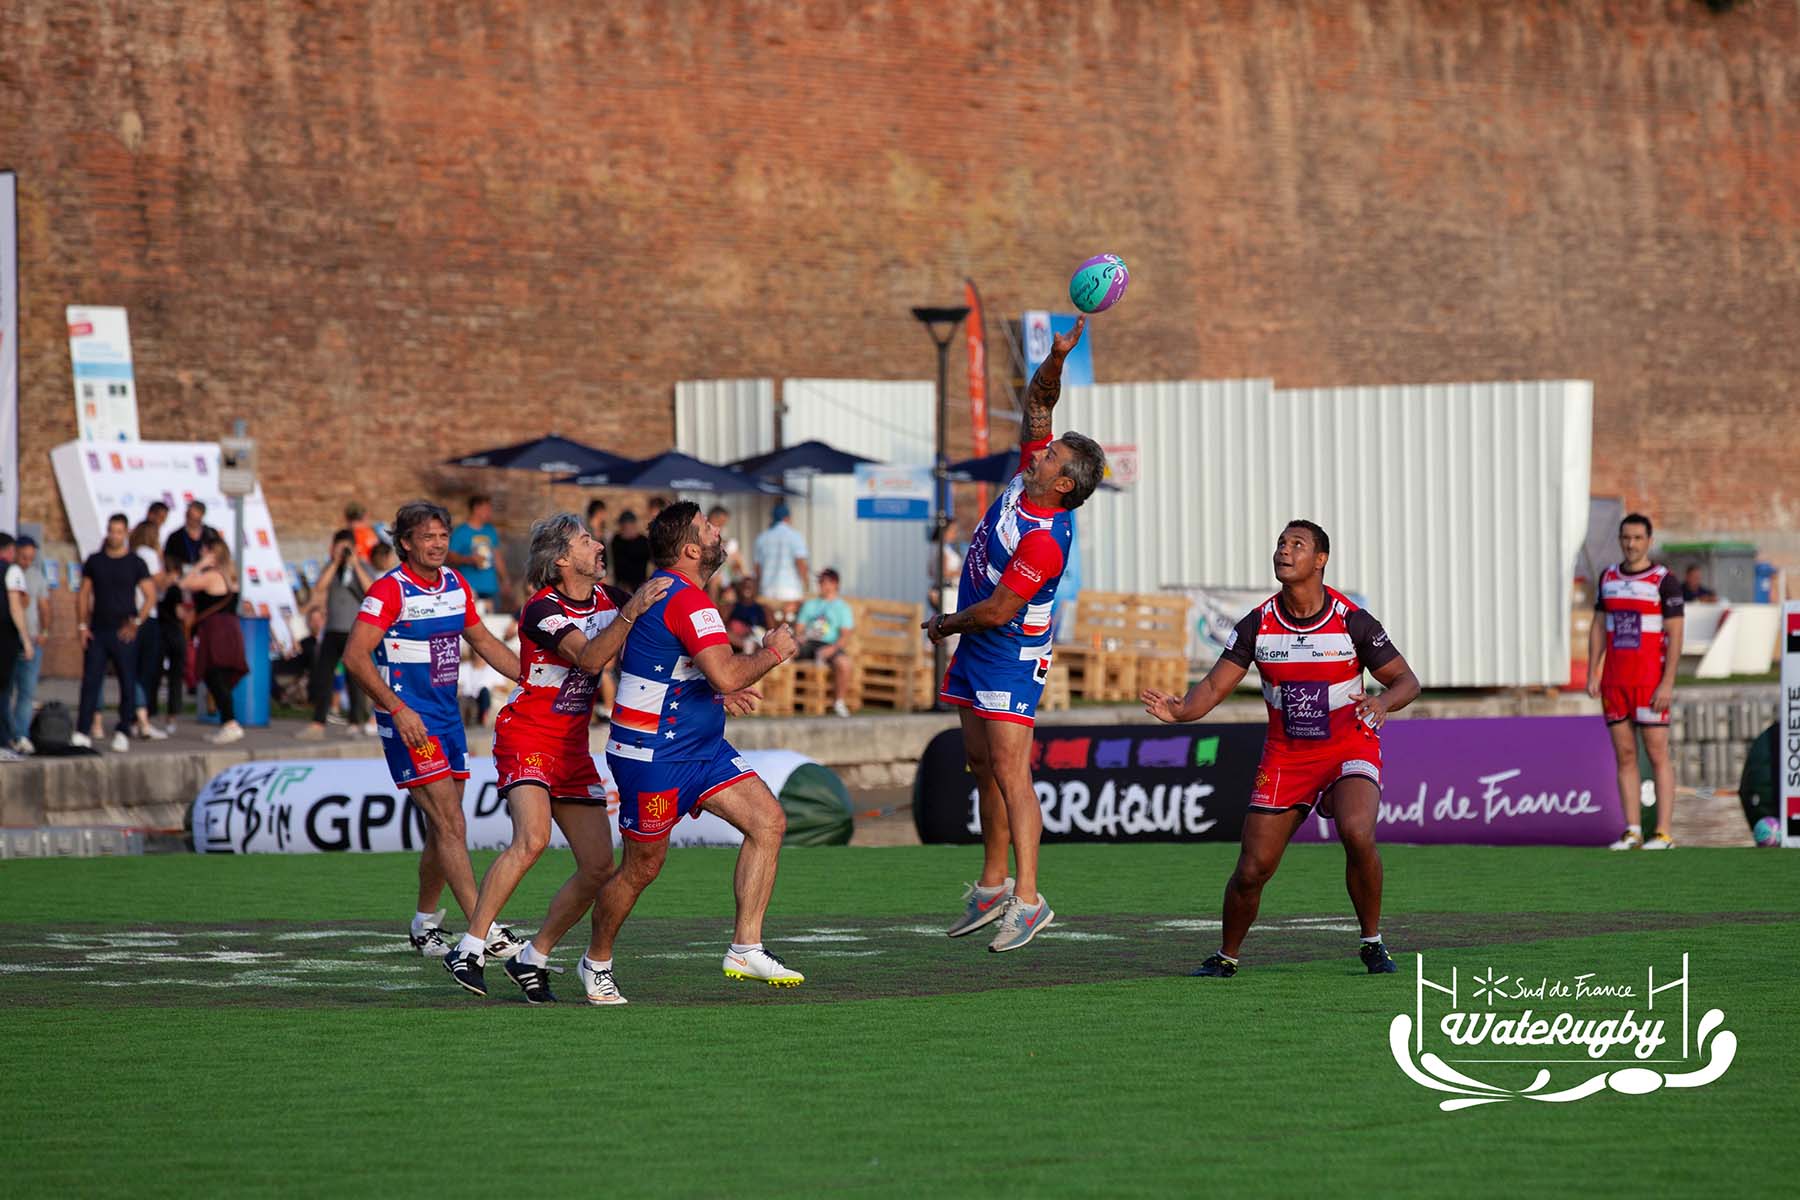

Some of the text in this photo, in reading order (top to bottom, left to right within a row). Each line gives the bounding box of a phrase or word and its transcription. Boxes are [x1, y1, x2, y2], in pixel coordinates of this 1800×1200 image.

[1269, 650, 1289, 658] GPM
[1296, 687, 1321, 702] Sud
[1286, 703, 1326, 720] France
[1298, 700, 1313, 711] de
[1787, 687, 1800, 788] SOCIETE
[1376, 768, 1602, 827] ud de France
